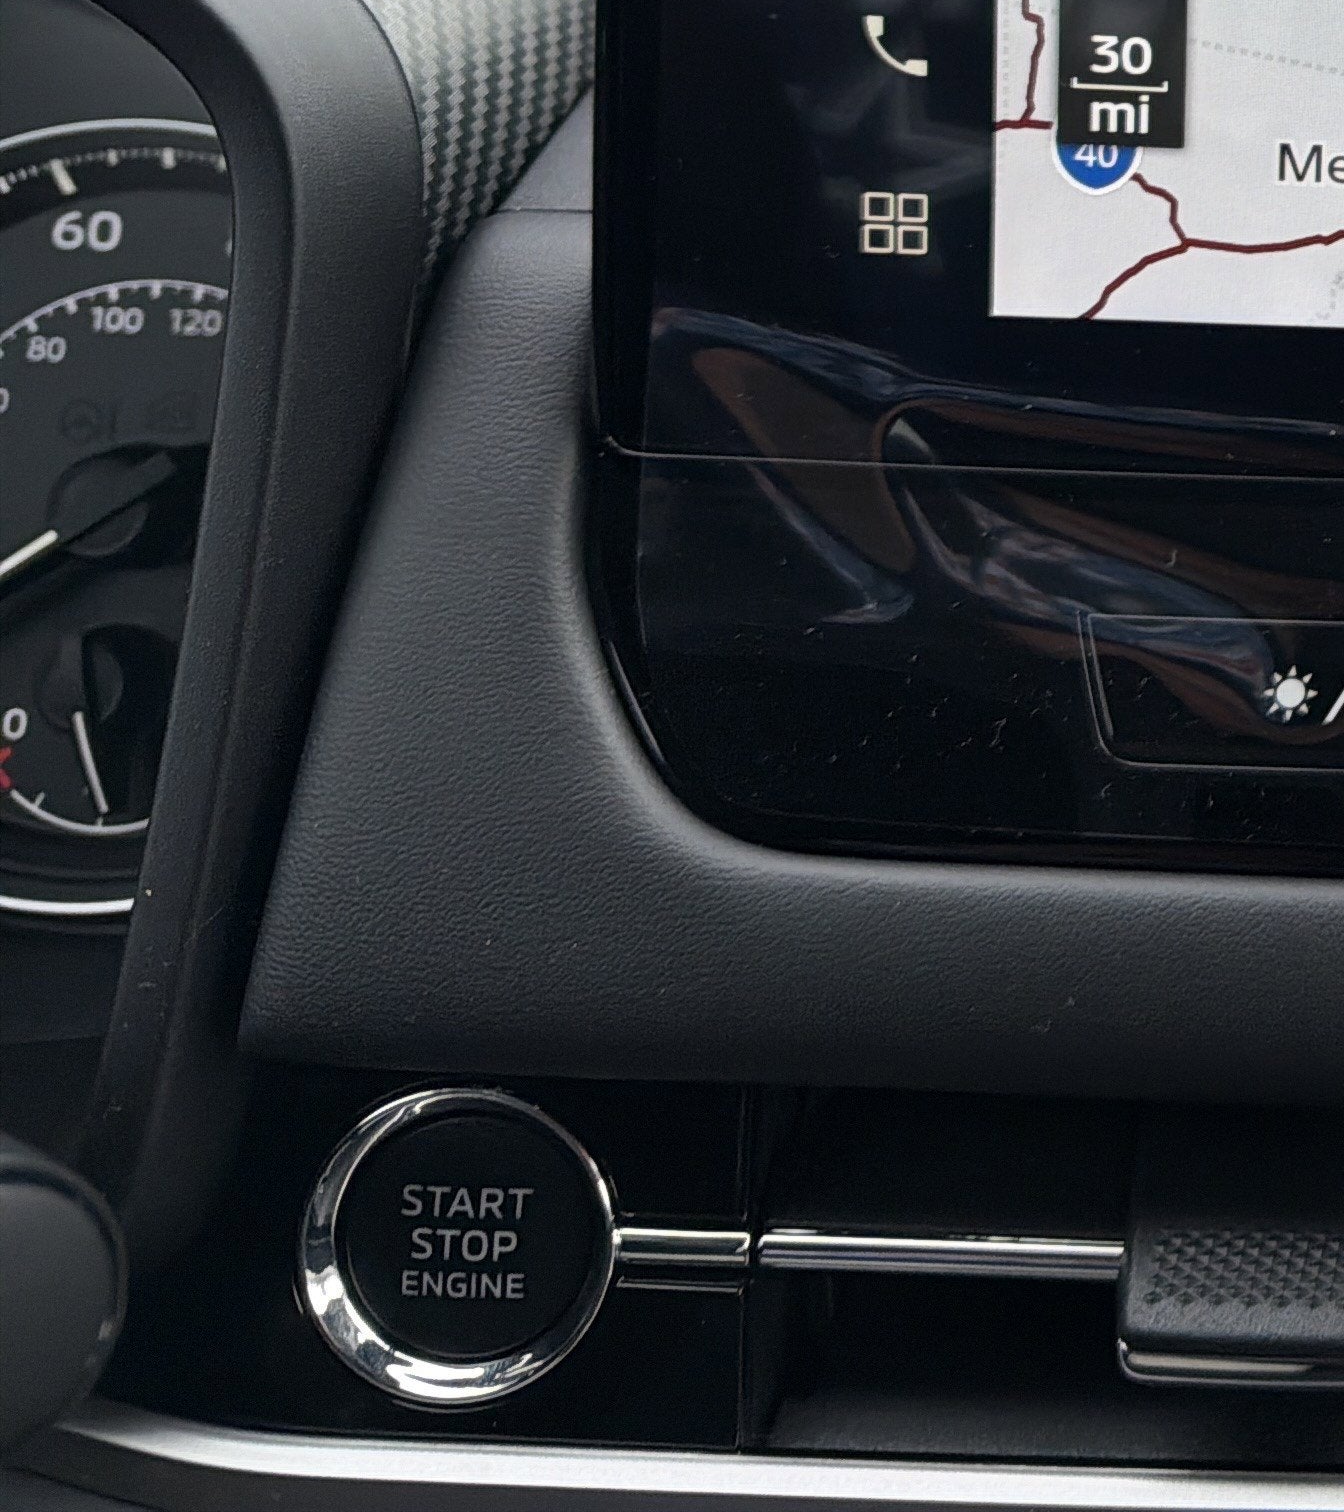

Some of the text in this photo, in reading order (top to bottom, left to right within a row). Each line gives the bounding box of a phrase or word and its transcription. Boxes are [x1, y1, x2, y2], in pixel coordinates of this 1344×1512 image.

[1089, 34, 1153, 76] 30
[1089, 94, 1150, 134] mi
[1073, 144, 1119, 168] 40
[51, 209, 123, 253] 60
[90, 305, 146, 336] 100
[168, 307, 224, 338] 120
[25, 334, 68, 365] 80
[400, 1183, 535, 1221] START
[410, 1226, 519, 1263] STOP
[400, 1269, 525, 1300] ENGINE
